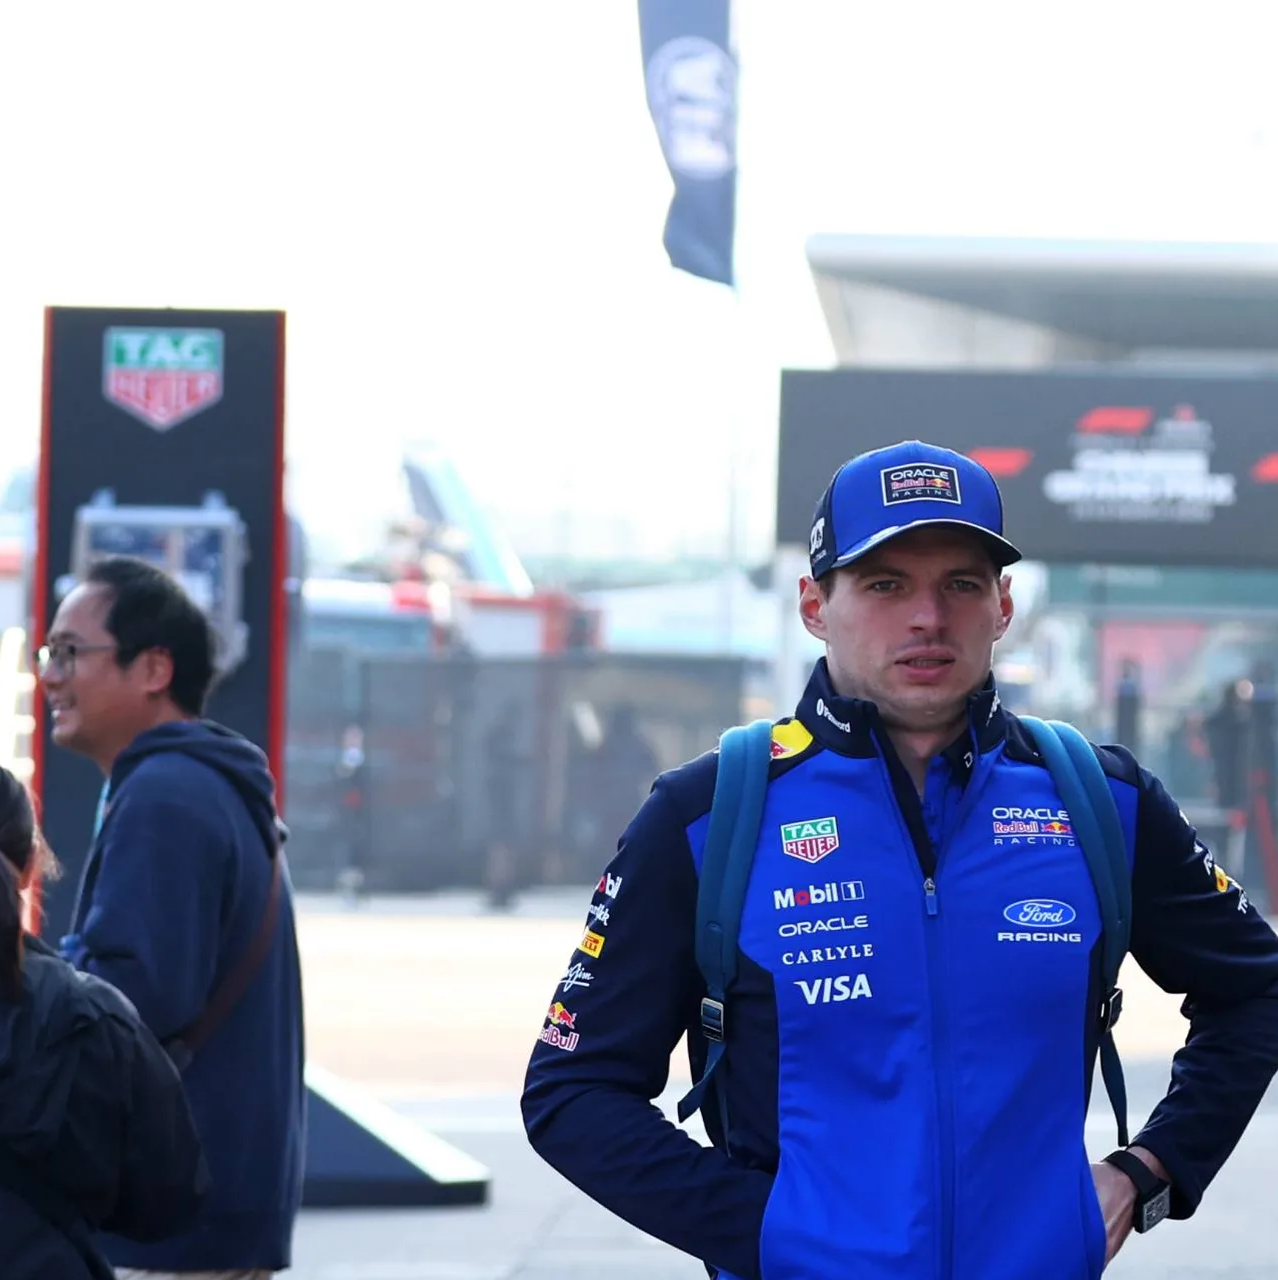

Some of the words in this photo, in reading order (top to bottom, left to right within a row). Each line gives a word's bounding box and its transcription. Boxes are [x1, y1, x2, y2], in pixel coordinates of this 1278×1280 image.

[112, 332, 215, 368] TAG
[890, 468, 951, 480] ORACLE
[892, 488, 953, 498] RACING
[992, 807, 1070, 821] ORACLE
[785, 820, 832, 840] TAG
[787, 837, 836, 860] HEUER
[994, 837, 1075, 846] RACING
[773, 882, 839, 910] Mobil
[1018, 902, 1064, 923] Ford
[779, 915, 869, 937] ORACLE
[997, 932, 1081, 942] RACING
[782, 944, 874, 965] CARLYLE
[793, 973, 872, 1005] VISA
